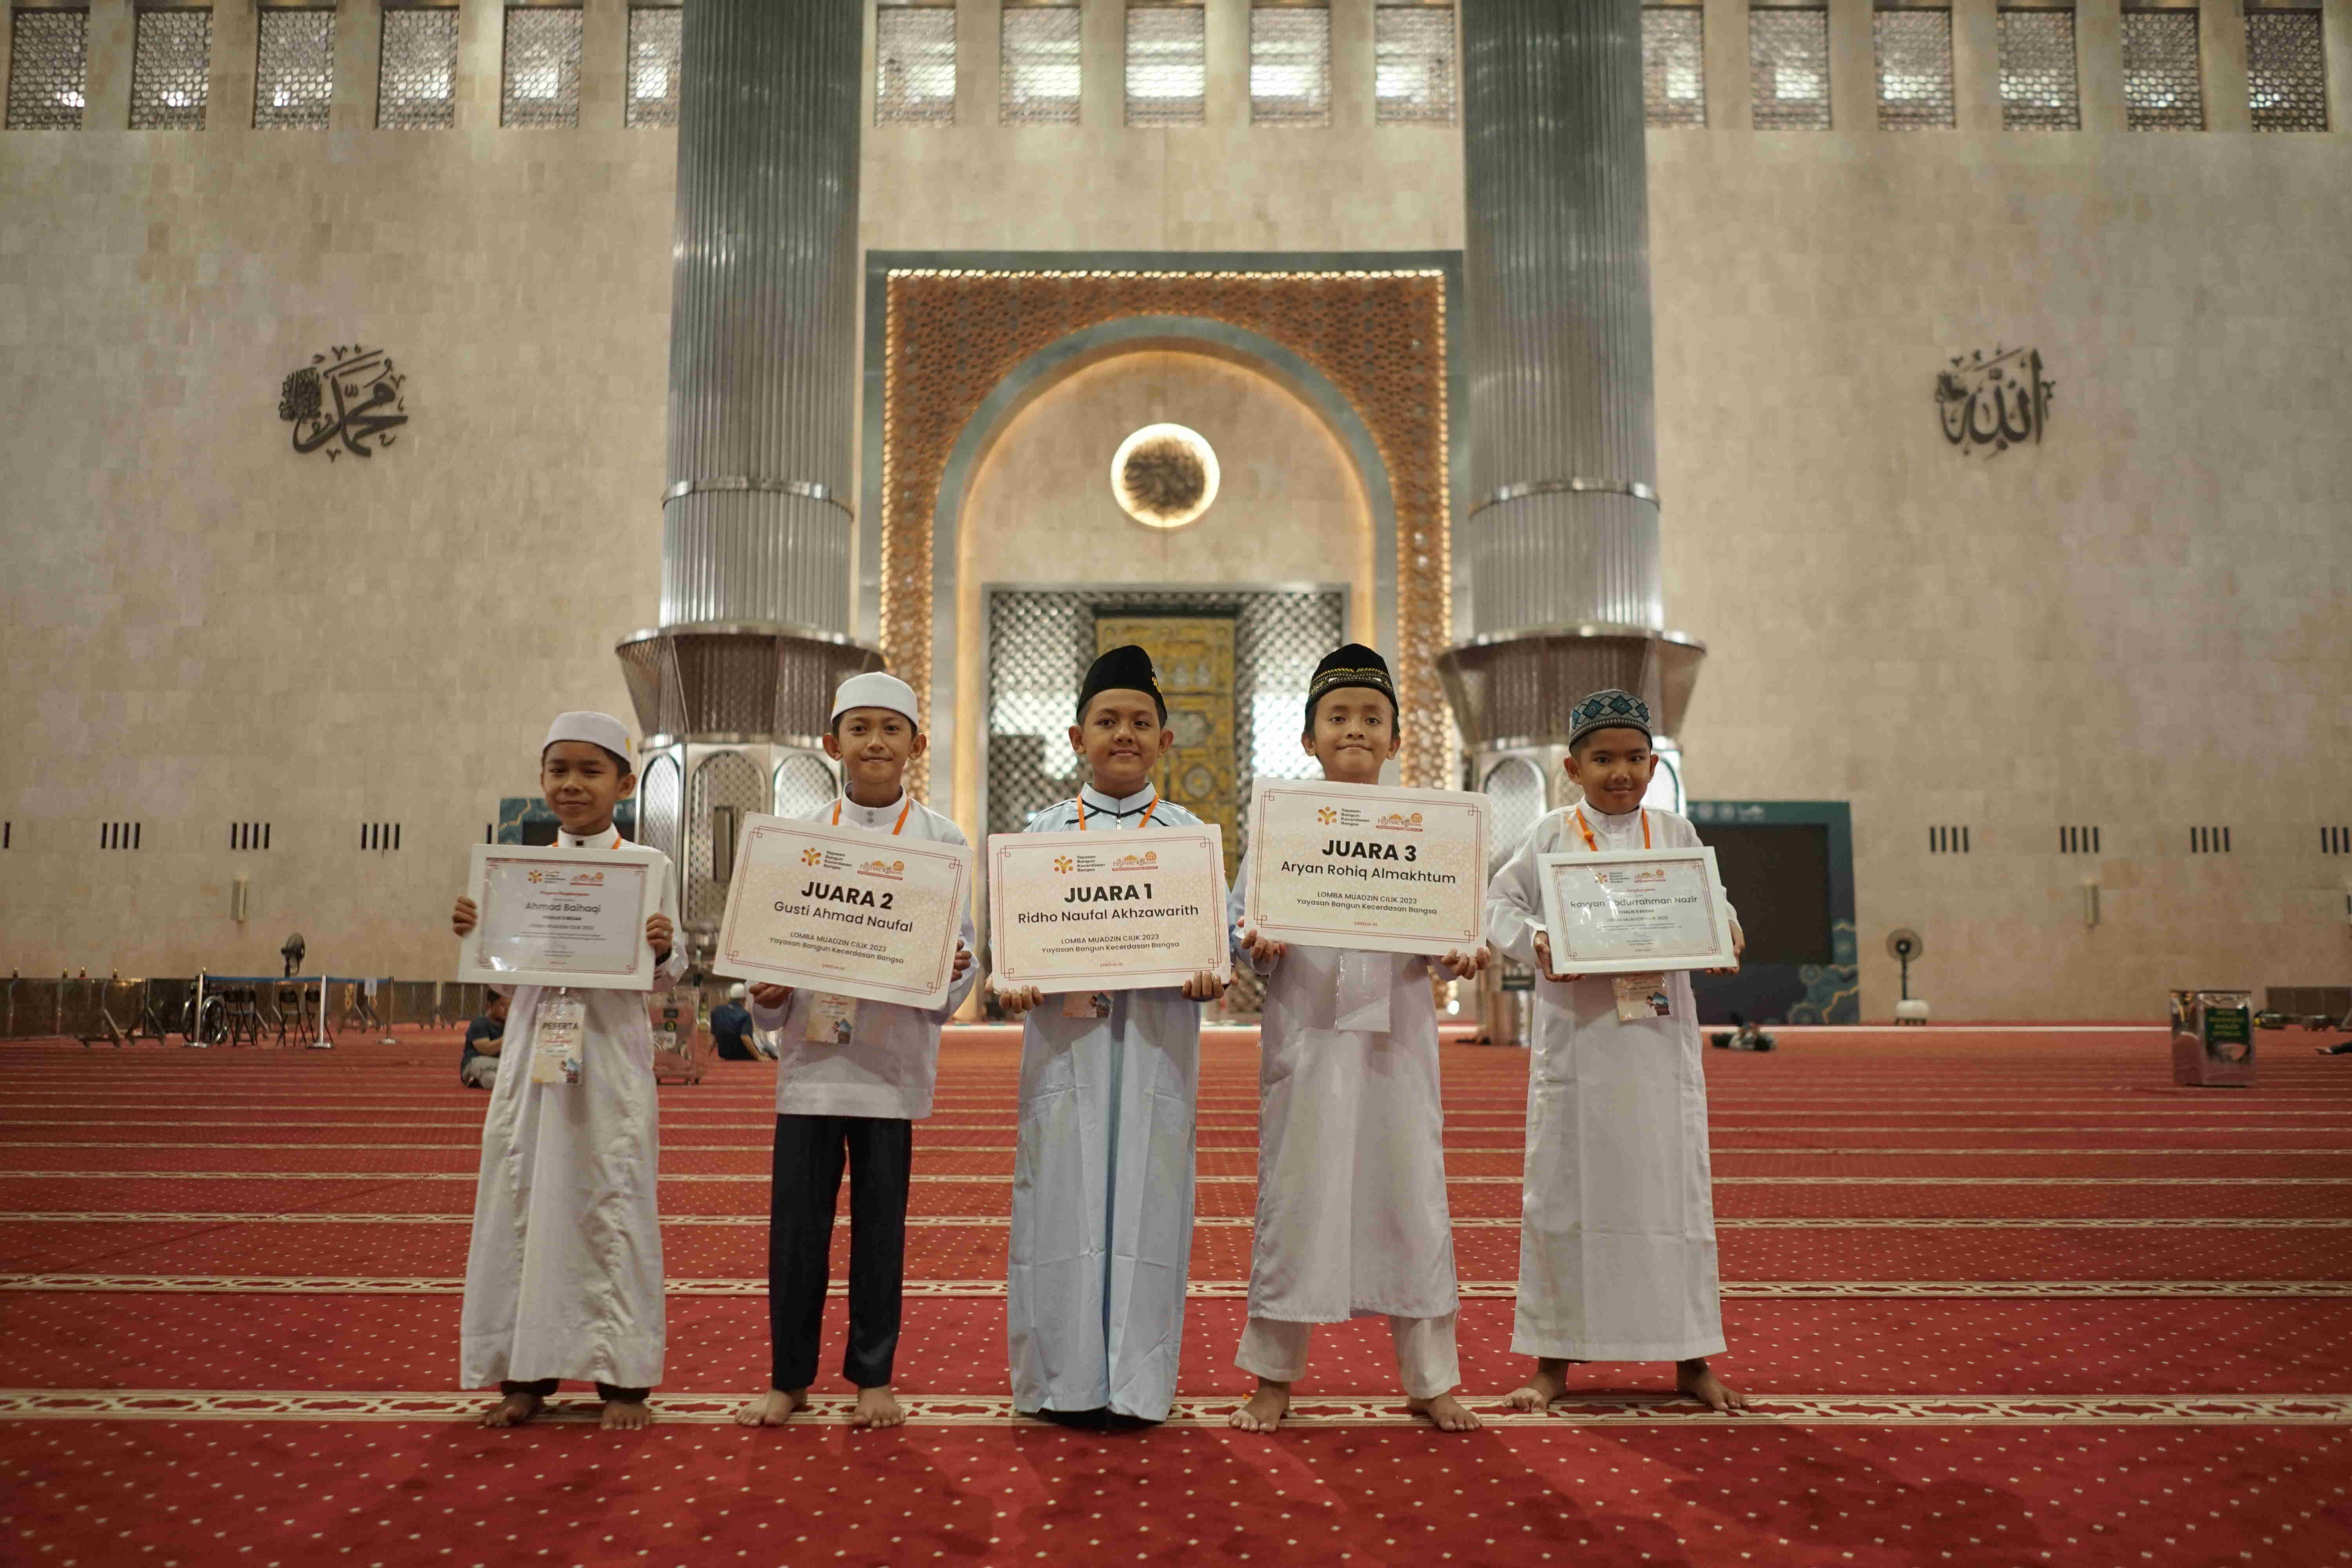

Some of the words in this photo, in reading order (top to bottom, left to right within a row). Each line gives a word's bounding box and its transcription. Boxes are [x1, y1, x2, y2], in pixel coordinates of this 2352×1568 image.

[1322, 840, 1399, 860] JUARA
[1405, 845, 1416, 862] 3
[1281, 861, 1323, 876] Aryan
[1328, 864, 1367, 880] Rohiq
[1372, 868, 1455, 884] Almakhtum
[801, 881, 875, 907] JUARA
[880, 893, 893, 909] 2
[1064, 885, 1140, 903] JUARA
[1144, 883, 1152, 899] 1
[1609, 898, 1671, 906] bdurrahman
[525, 902, 561, 911] Ahmad
[774, 901, 810, 916] Gusti
[812, 907, 864, 924] Ahmad
[867, 916, 913, 932] Naufal
[1018, 912, 1057, 923] Ridho
[1062, 909, 1107, 921] Naufal
[1112, 905, 1198, 919] Akhzawarith
[1331, 901, 1360, 909] Bangun
[1362, 903, 1406, 912] Kecerdasan
[1409, 907, 1436, 915] Bangsa
[790, 932, 814, 940] LOMBA
[817, 936, 849, 946] MUADZIN
[770, 937, 800, 947] Yayasan
[802, 942, 830, 952] Bangun
[832, 947, 875, 958] Kecerdasan
[877, 954, 903, 964] Bangsa
